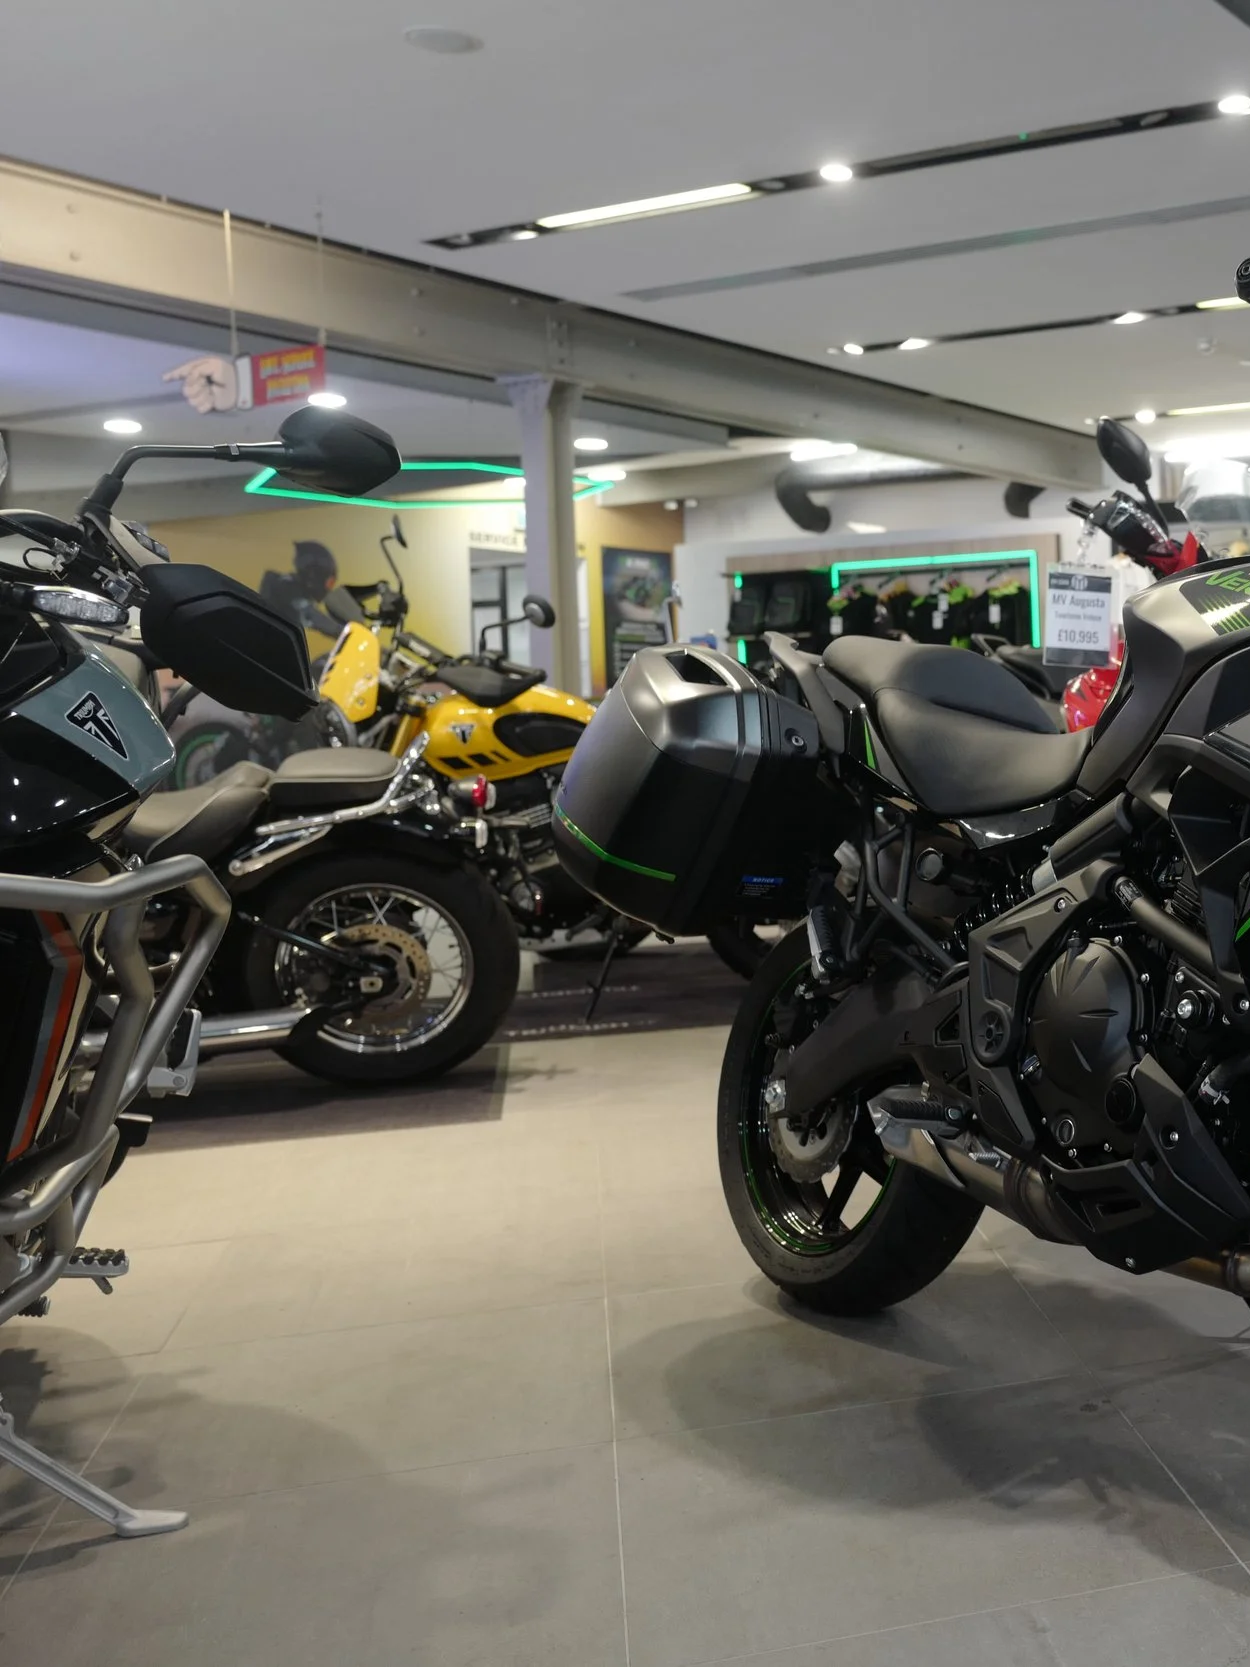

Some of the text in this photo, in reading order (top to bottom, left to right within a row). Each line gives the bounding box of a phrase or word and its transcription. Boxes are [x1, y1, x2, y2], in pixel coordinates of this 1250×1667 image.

[1052, 593, 1105, 609] MV Augusta
[1058, 629, 1099, 644] £10,995
